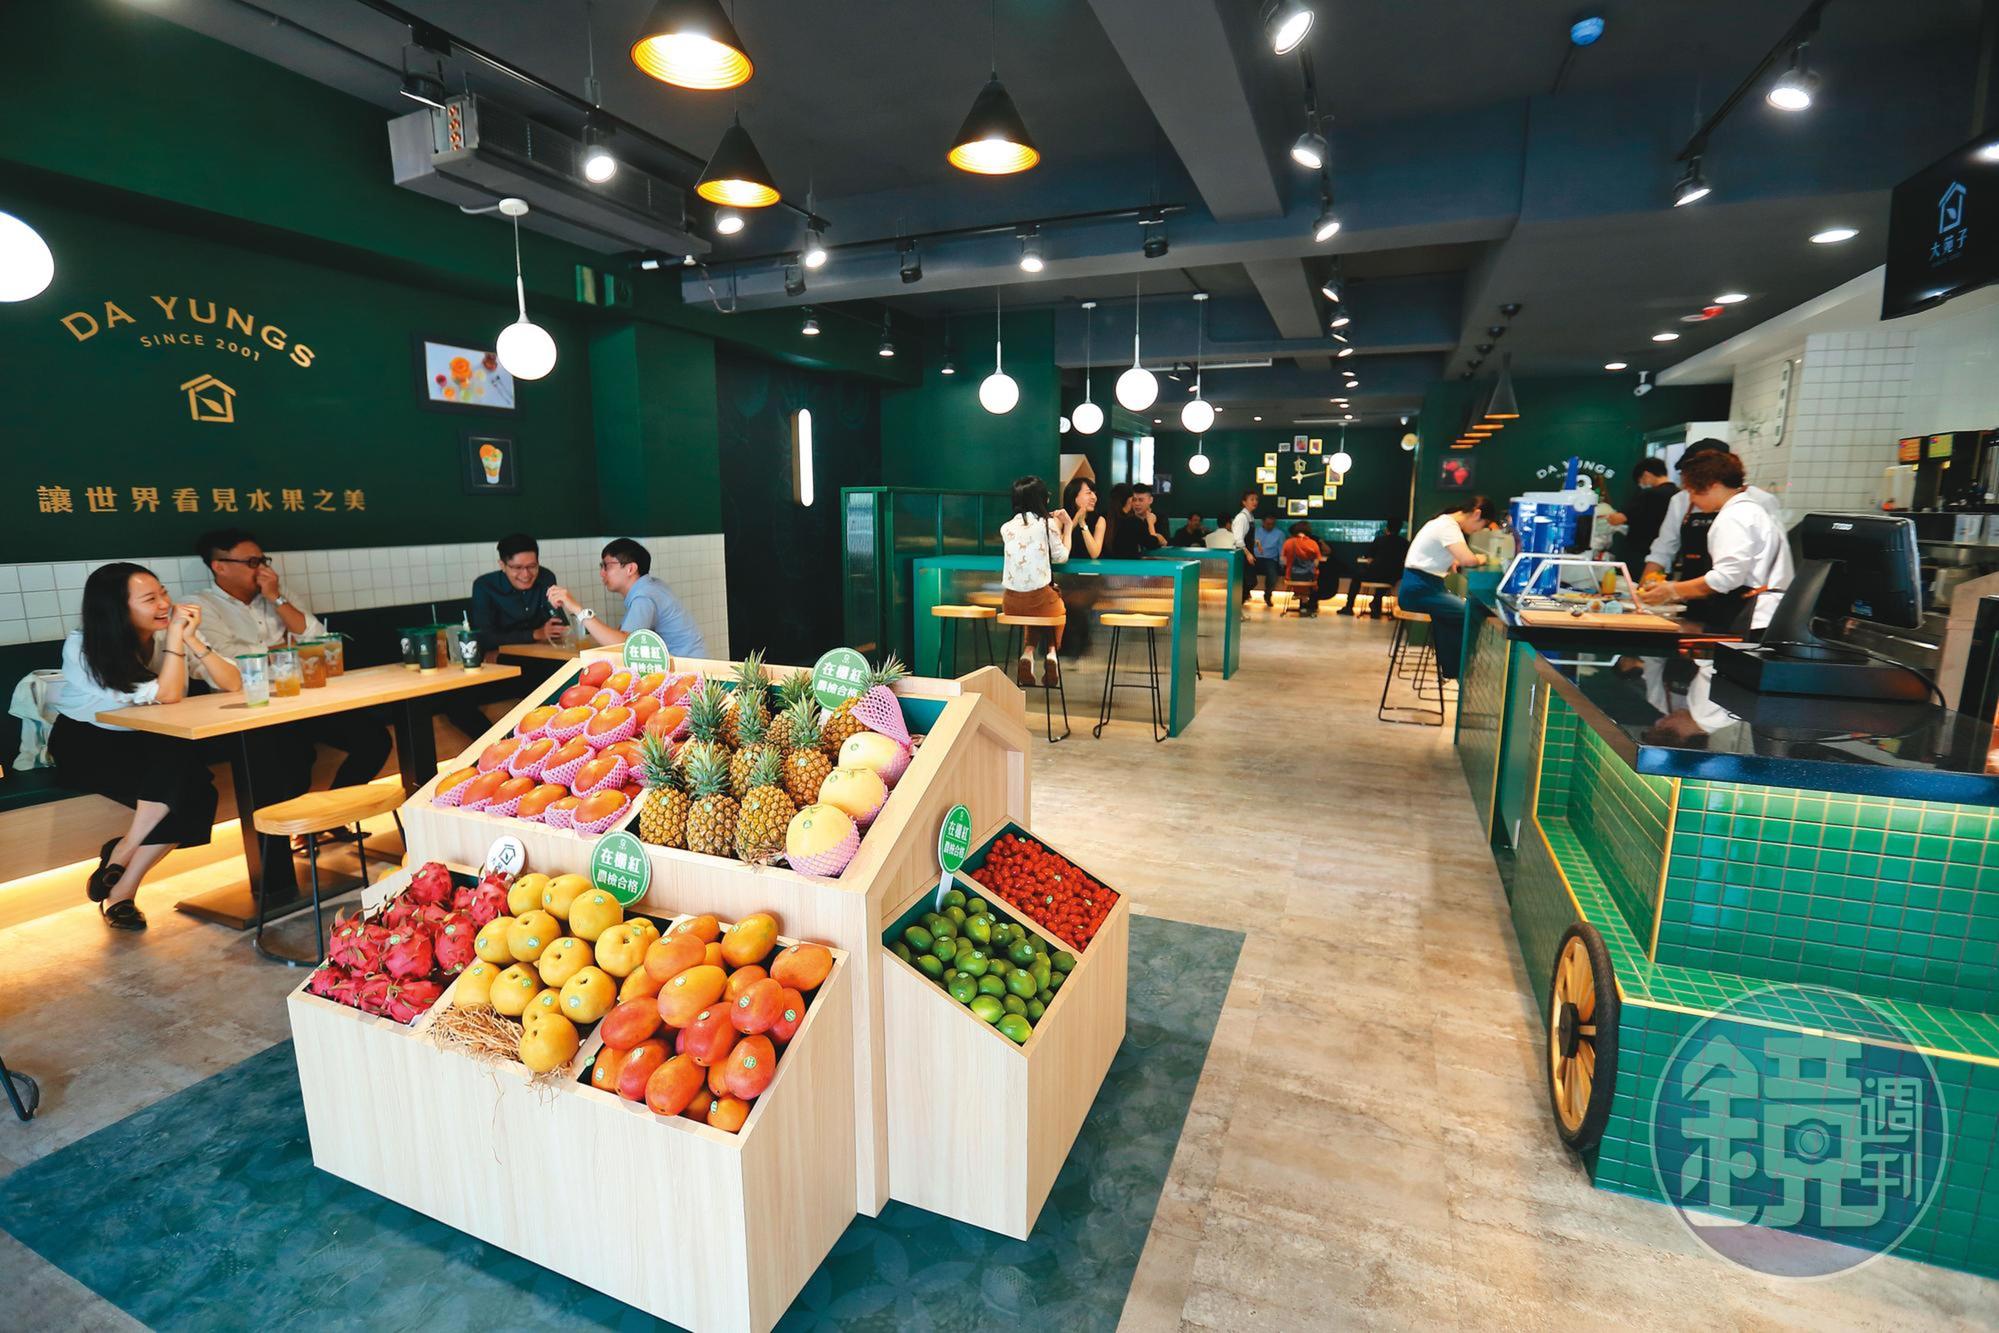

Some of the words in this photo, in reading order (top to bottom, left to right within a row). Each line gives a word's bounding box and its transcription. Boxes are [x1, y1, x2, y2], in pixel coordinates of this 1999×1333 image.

[60, 301, 137, 342] DA
[150, 296, 316, 367] YUNGS
[140, 333, 205, 348] SINCE
[215, 338, 260, 361] 2001
[1536, 464, 1558, 479] DA
[36, 485, 367, 513] 讓世界看見水果之美
